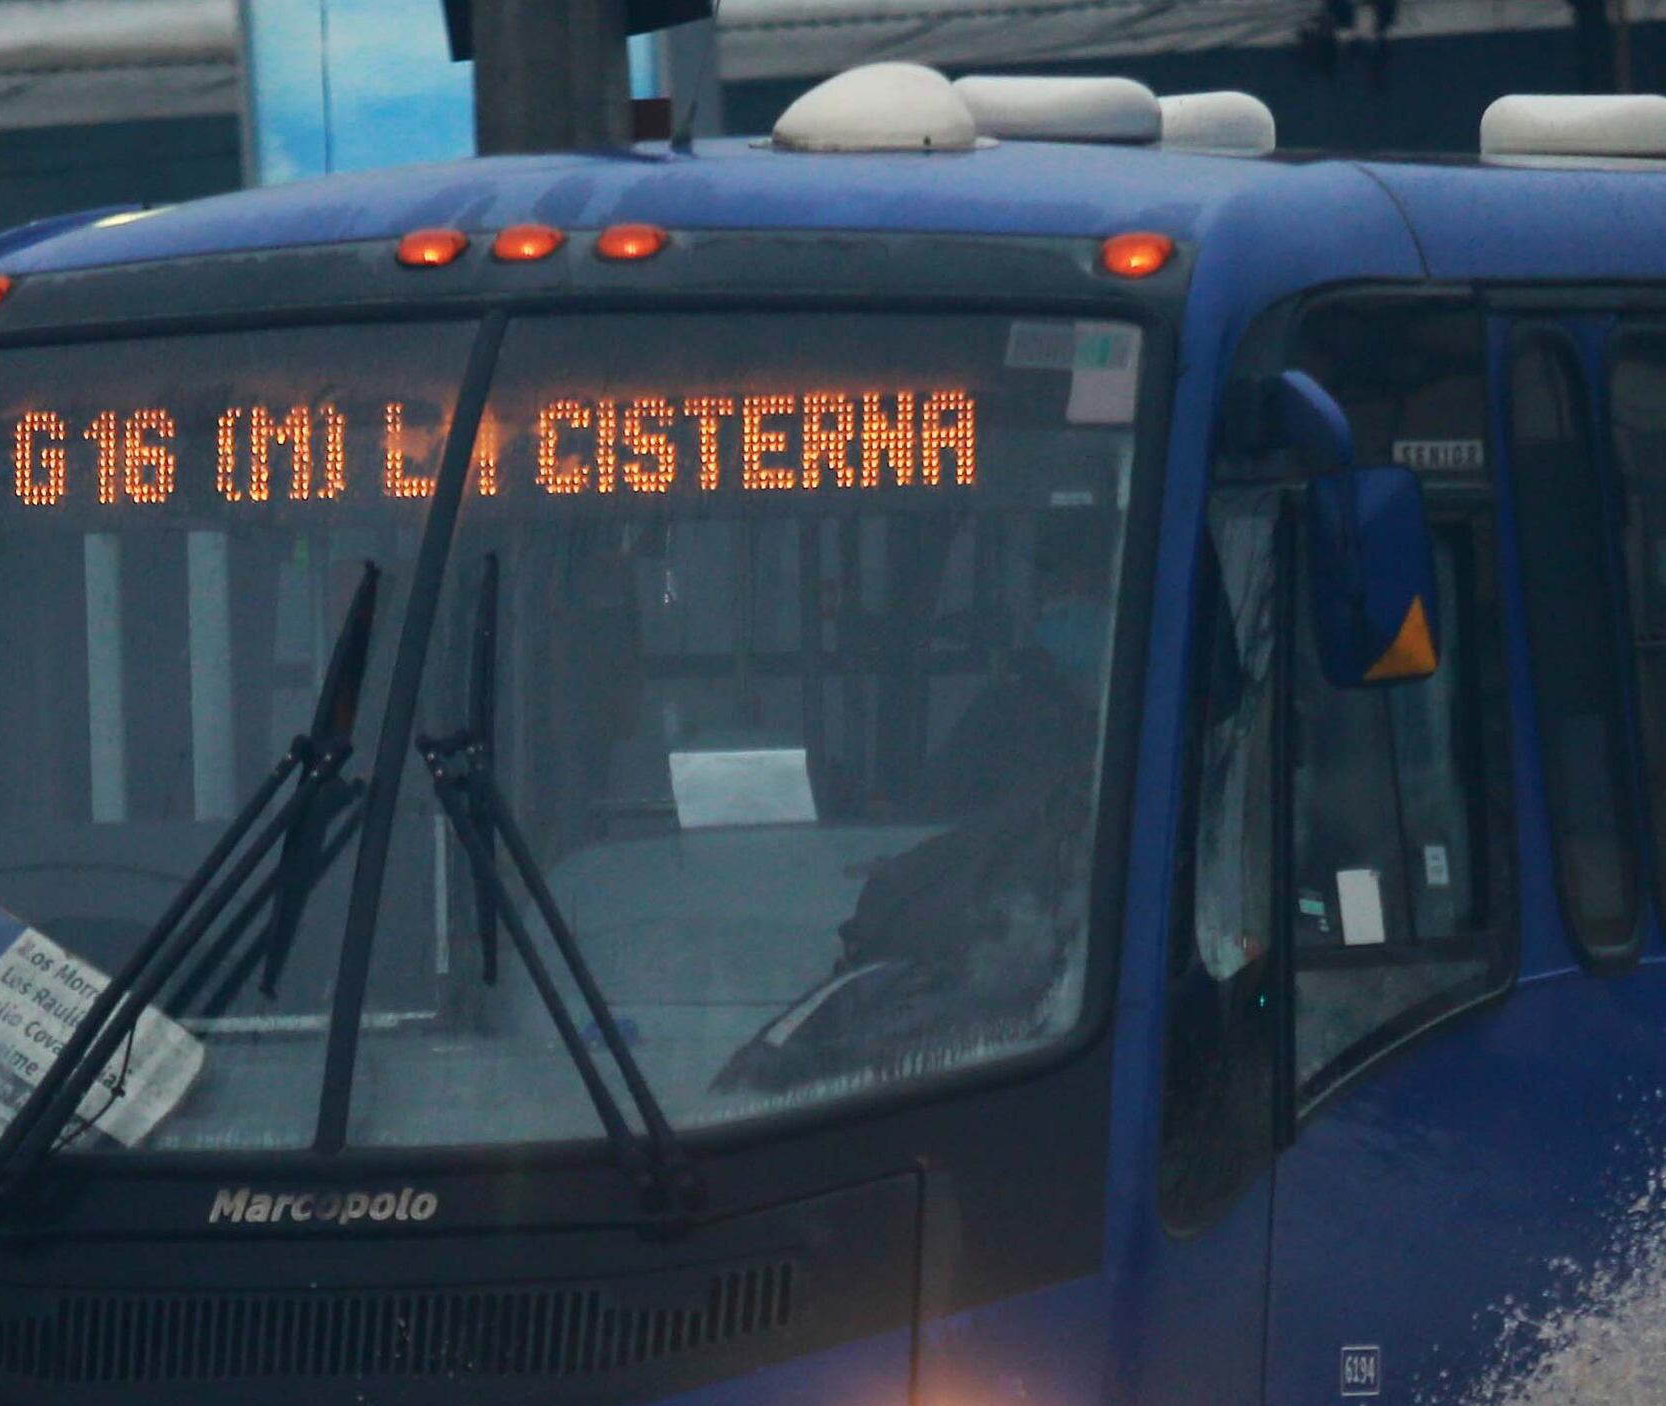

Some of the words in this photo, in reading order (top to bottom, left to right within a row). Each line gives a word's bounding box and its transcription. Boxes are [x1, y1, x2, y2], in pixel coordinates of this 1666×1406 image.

[217, 406, 345, 502] (M)
[536, 391, 976, 494] CISTERNA
[208, 1186, 438, 1224] Marcopolo
[1345, 1355, 1376, 1384] 6194
